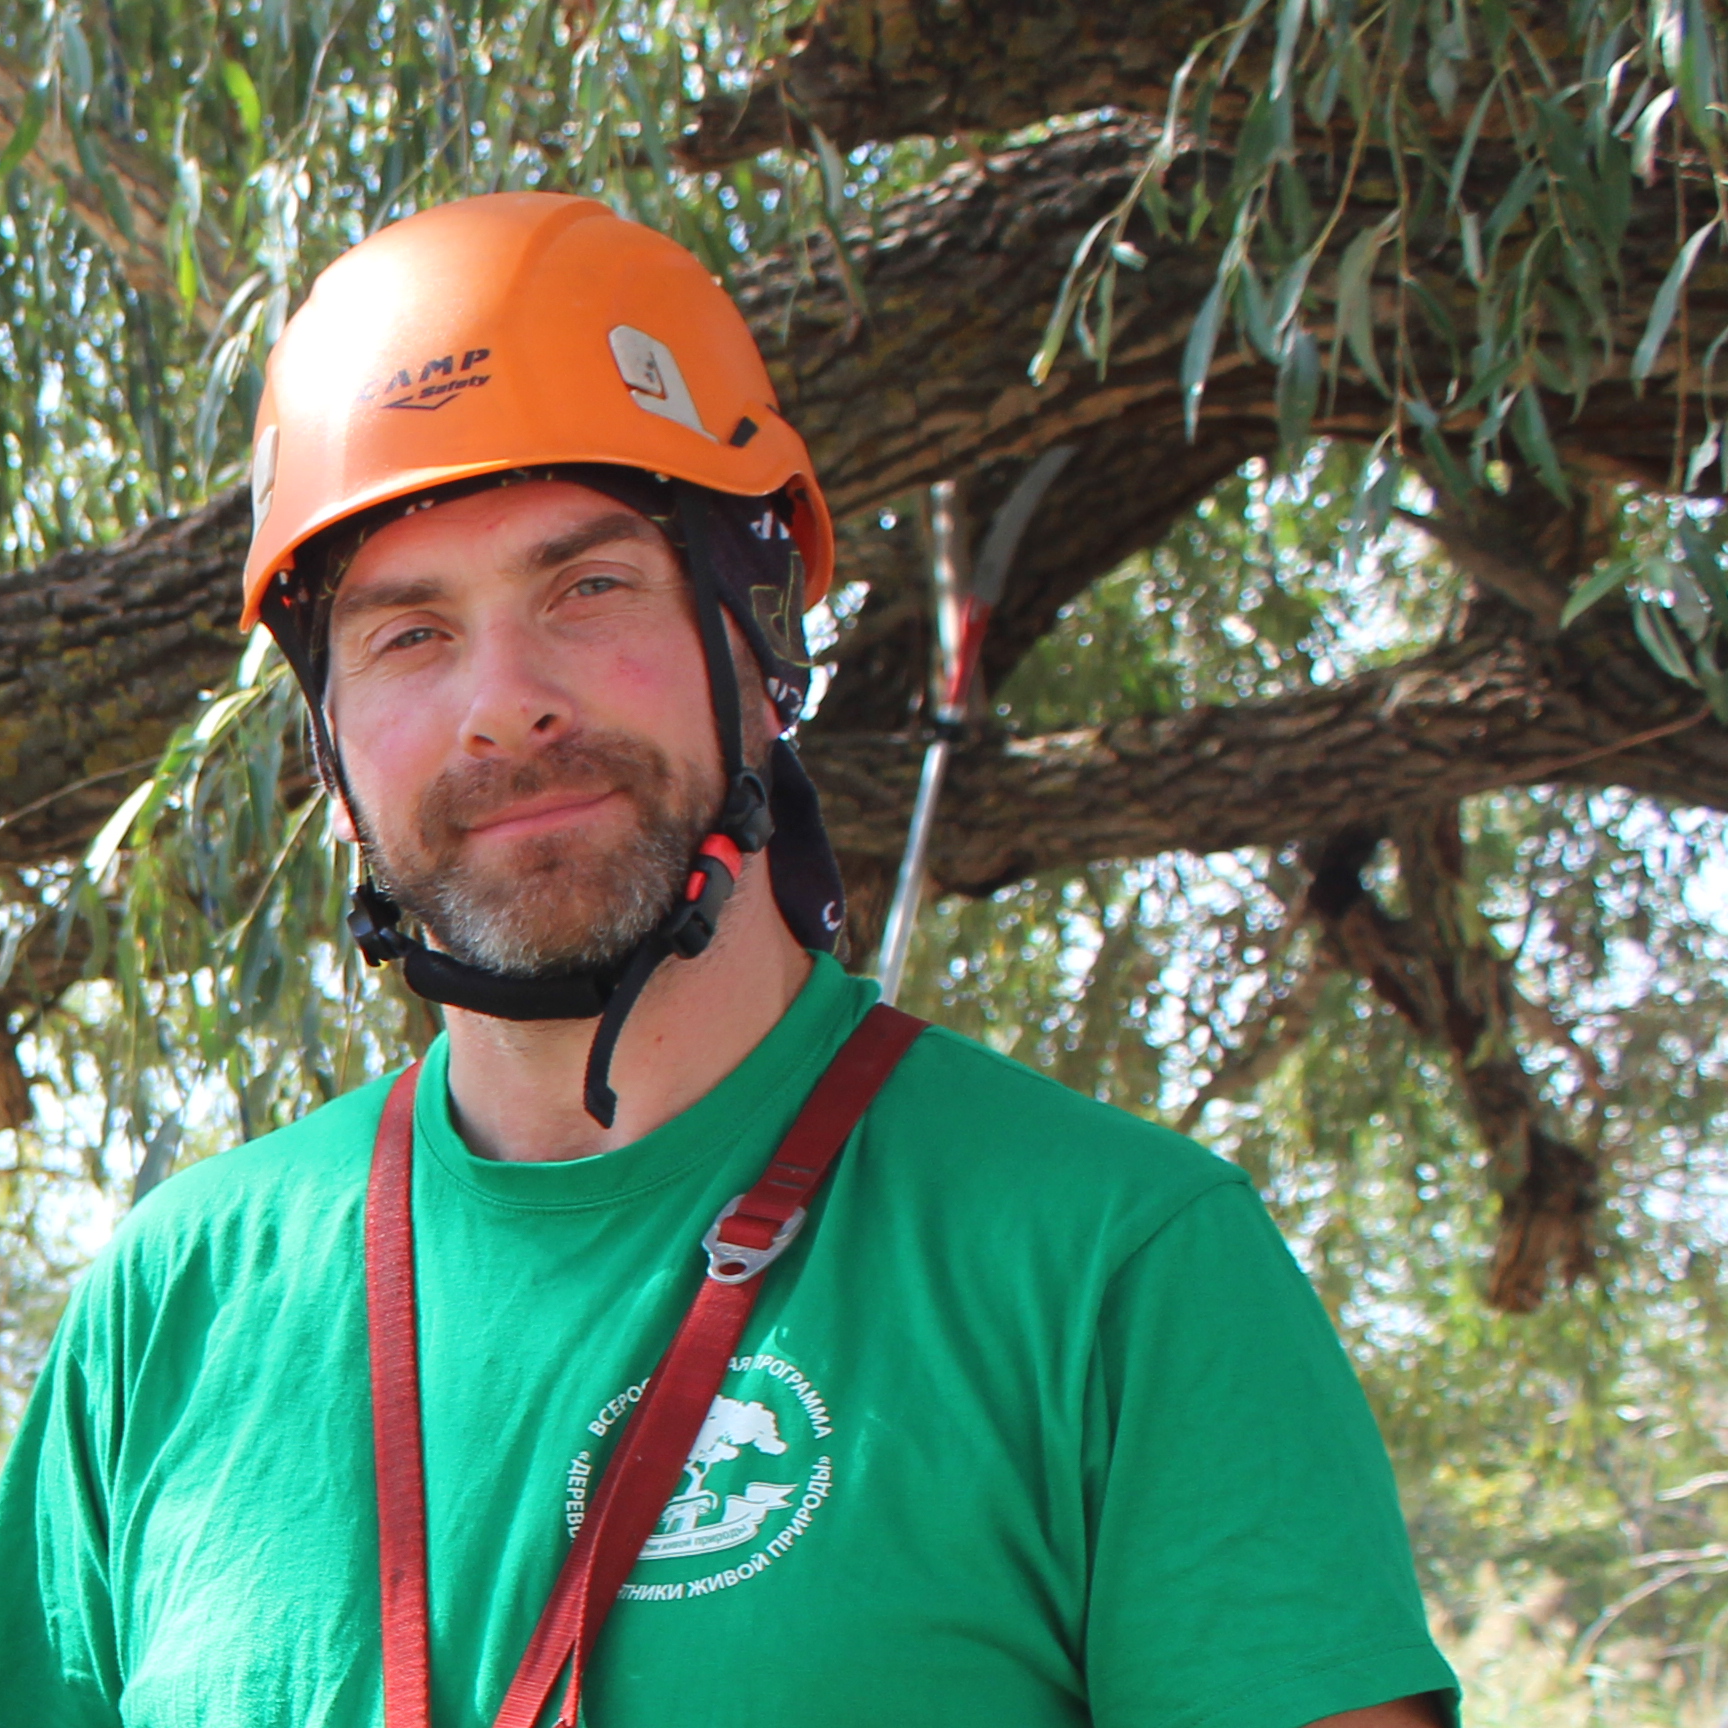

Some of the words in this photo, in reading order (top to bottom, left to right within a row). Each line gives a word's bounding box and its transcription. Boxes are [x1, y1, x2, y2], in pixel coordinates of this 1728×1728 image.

[357, 347, 491, 401] CAMP
[418, 374, 492, 400] Safety
[753, 1354, 834, 1440] ПРОГРАММА
[686, 1552, 772, 1599] ЖИВОЙ
[766, 1455, 834, 1558] ПРИРОДЫ»
